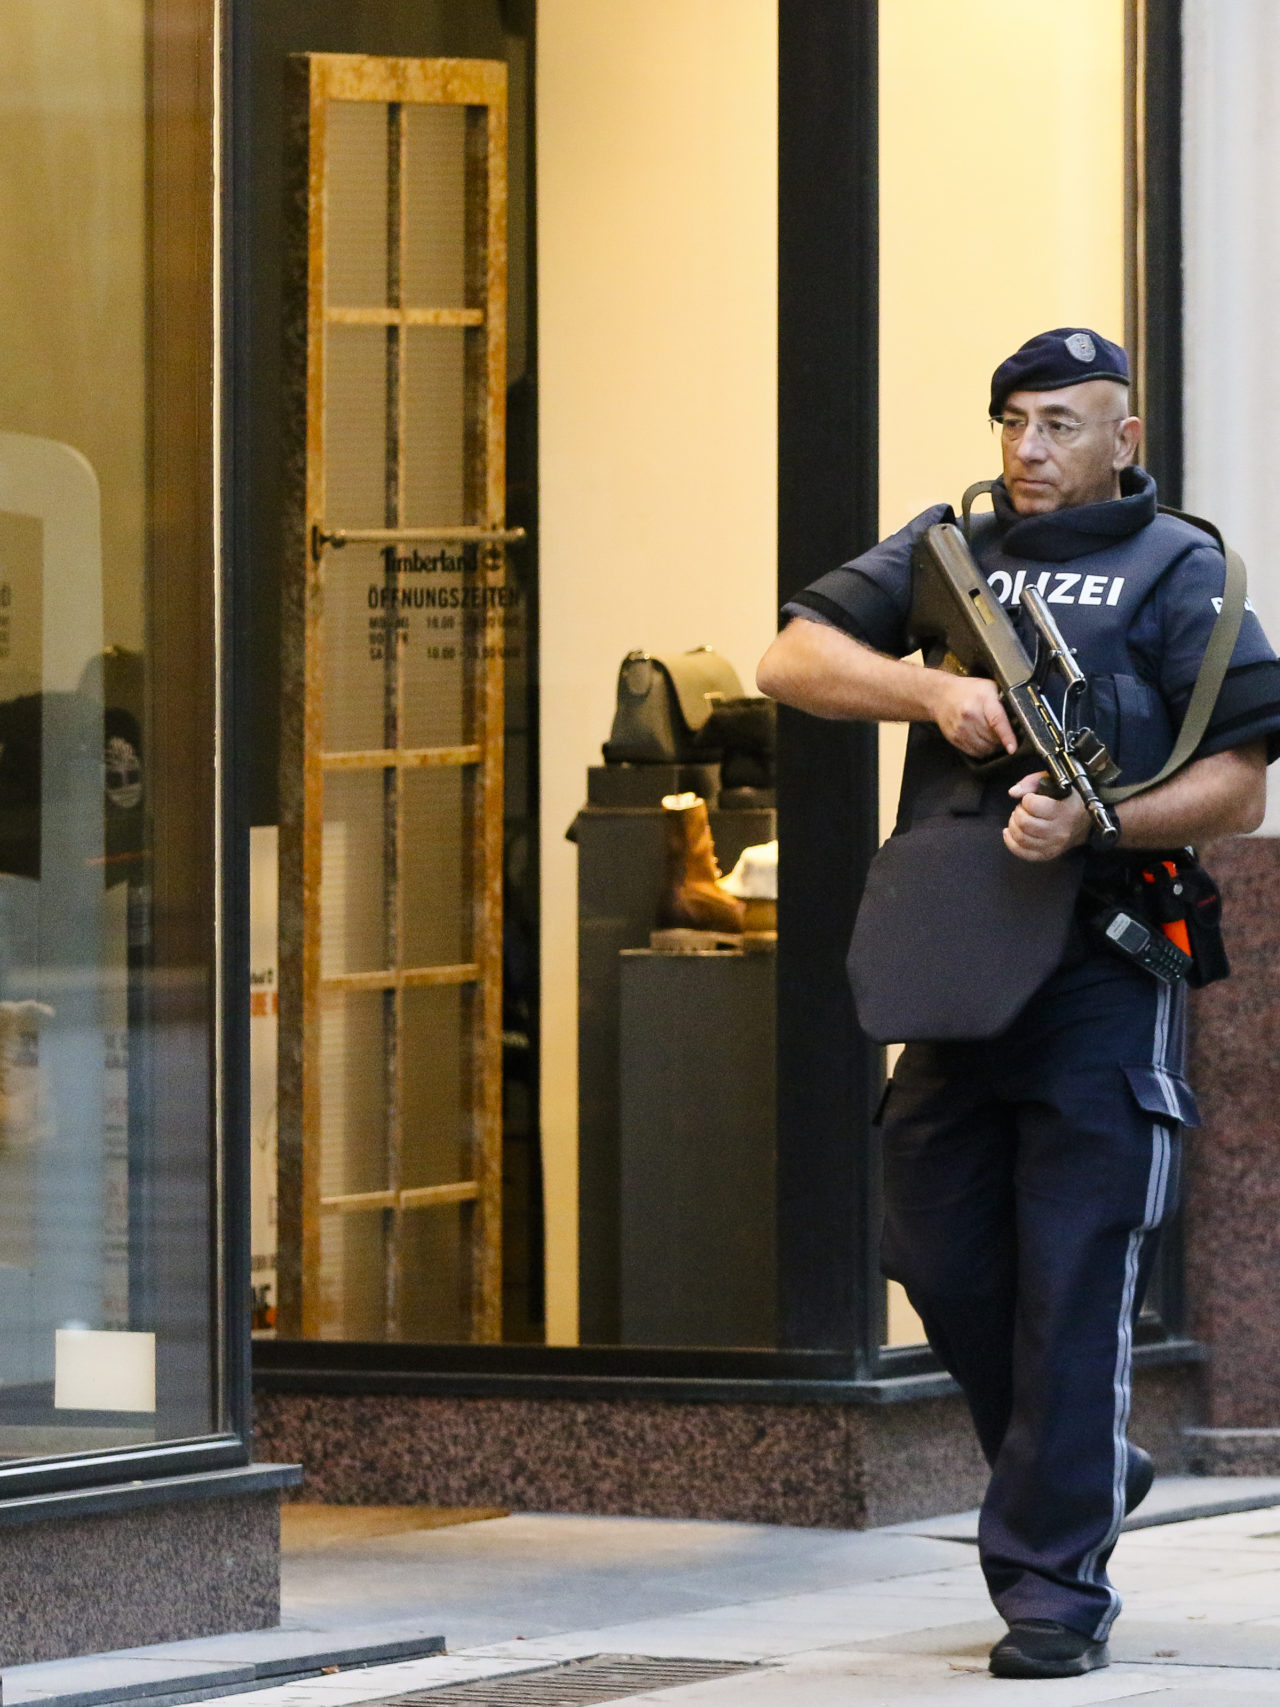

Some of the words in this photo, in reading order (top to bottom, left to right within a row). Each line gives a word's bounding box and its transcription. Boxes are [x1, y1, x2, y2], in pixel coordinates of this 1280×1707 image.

[380, 546, 478, 574] Timberland
[368, 584, 520, 609] ÖFFNUNGSZEITEN
[985, 569, 1126, 607] OLIZEI
